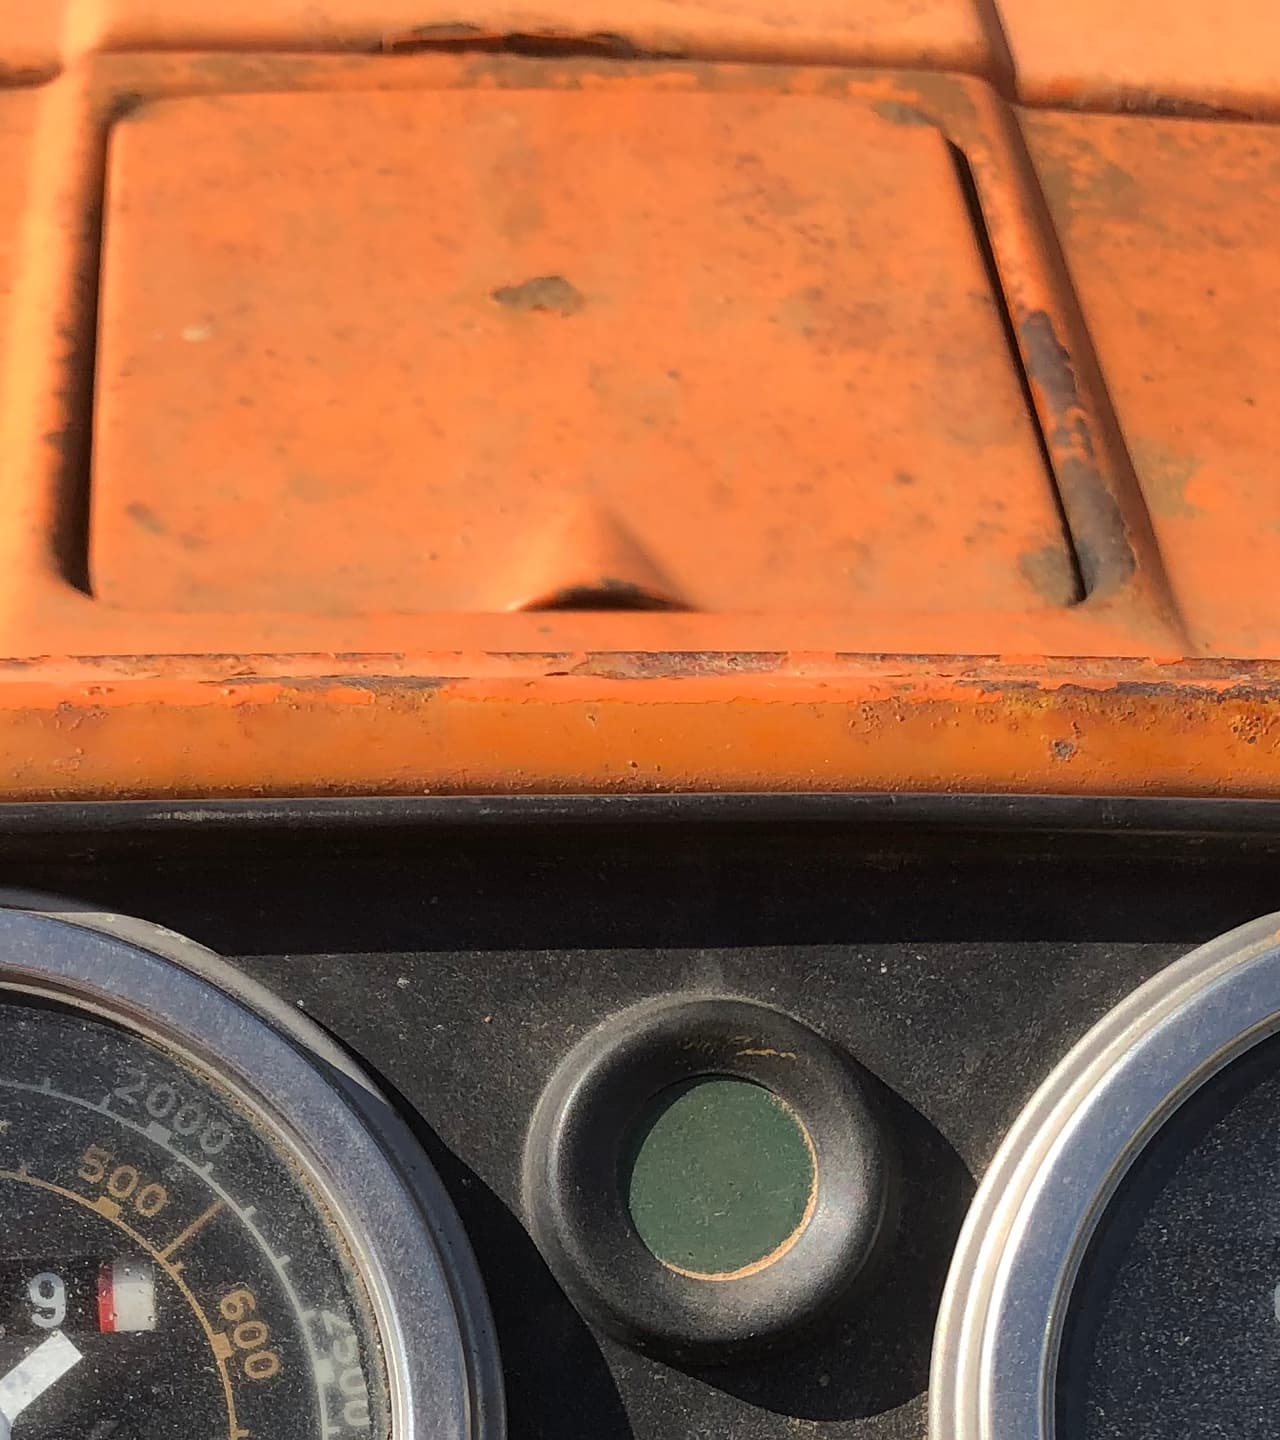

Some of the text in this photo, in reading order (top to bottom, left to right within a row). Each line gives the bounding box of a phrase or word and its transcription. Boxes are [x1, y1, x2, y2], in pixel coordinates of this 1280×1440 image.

[114, 1066, 233, 1154] 2000
[78, 1144, 168, 1217] 500
[220, 1288, 279, 1380] 600
